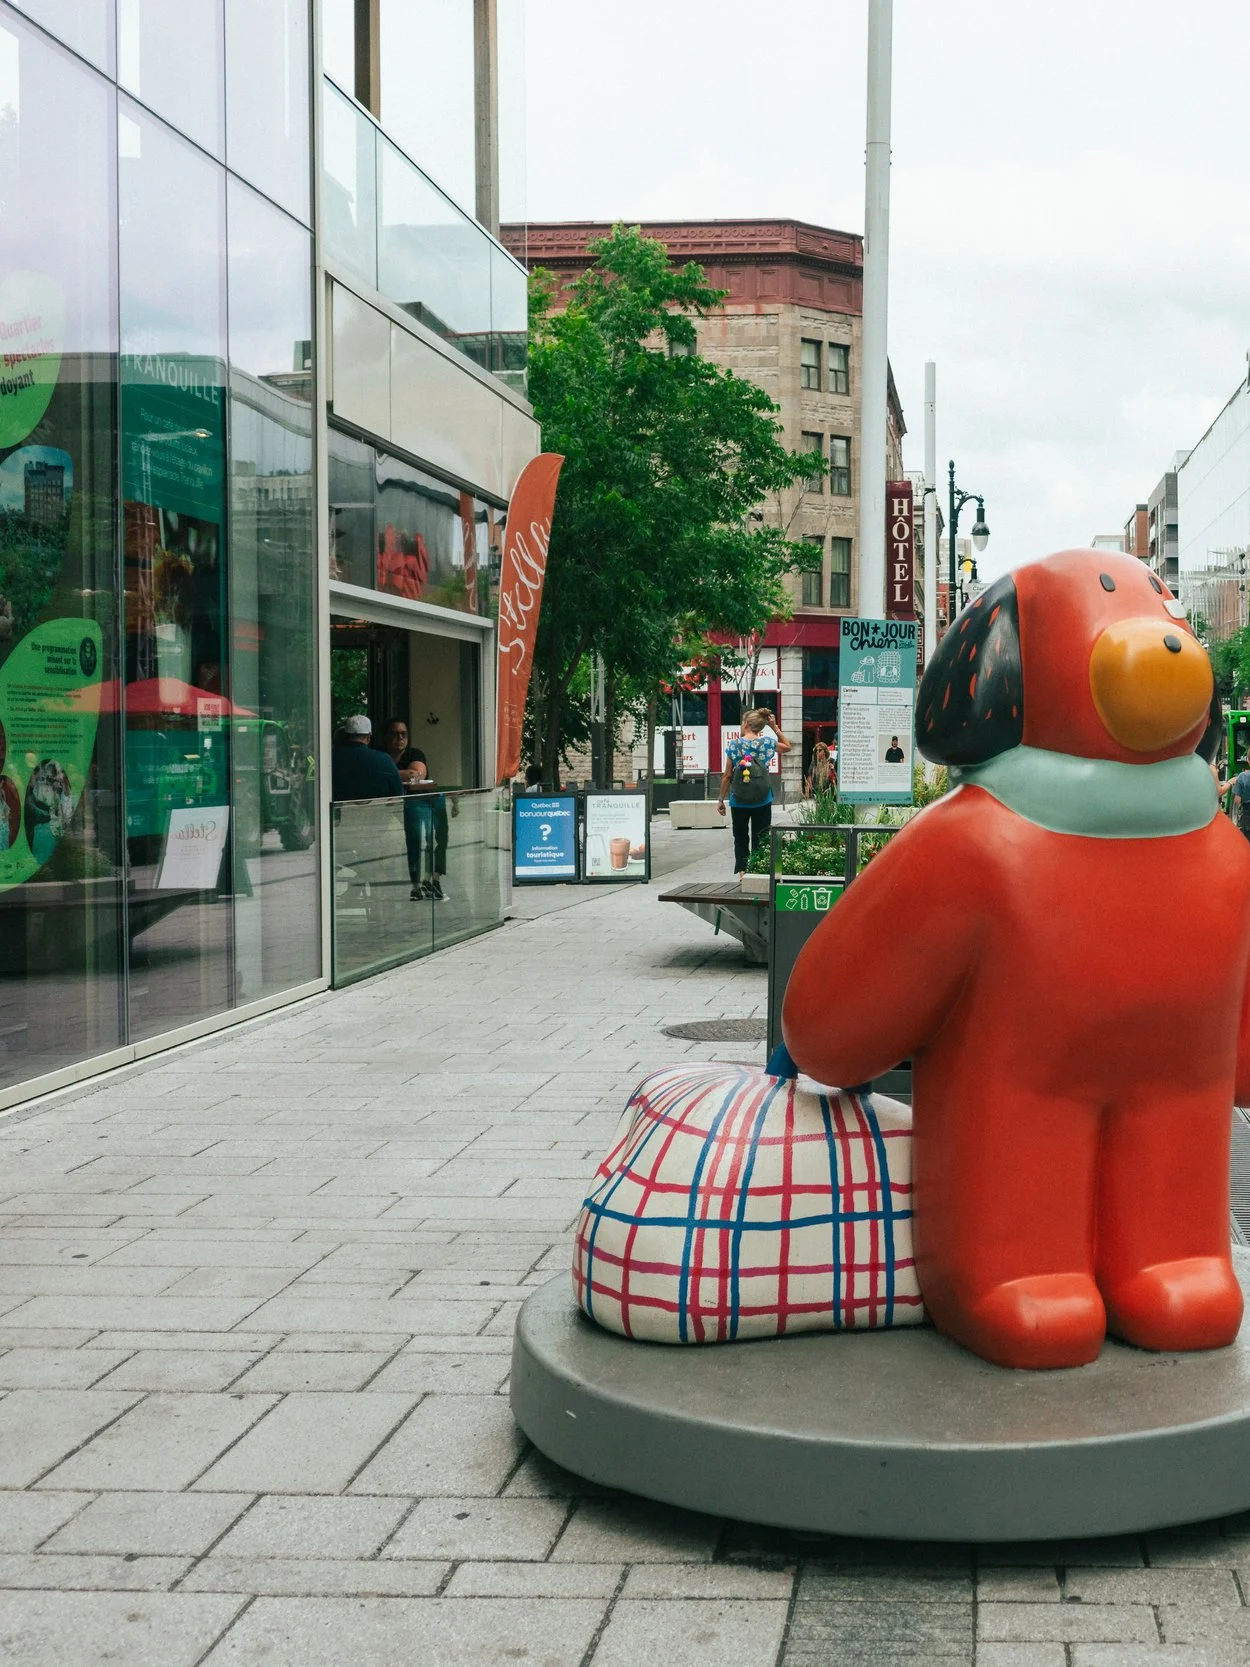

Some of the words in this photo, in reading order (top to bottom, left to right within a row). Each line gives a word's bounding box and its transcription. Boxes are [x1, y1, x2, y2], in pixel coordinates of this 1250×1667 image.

[123, 338, 219, 406] TRANQUILLE
[892, 498, 910, 602] HÔTEL
[842, 621, 870, 637] BON
[881, 623, 916, 640] JOUR
